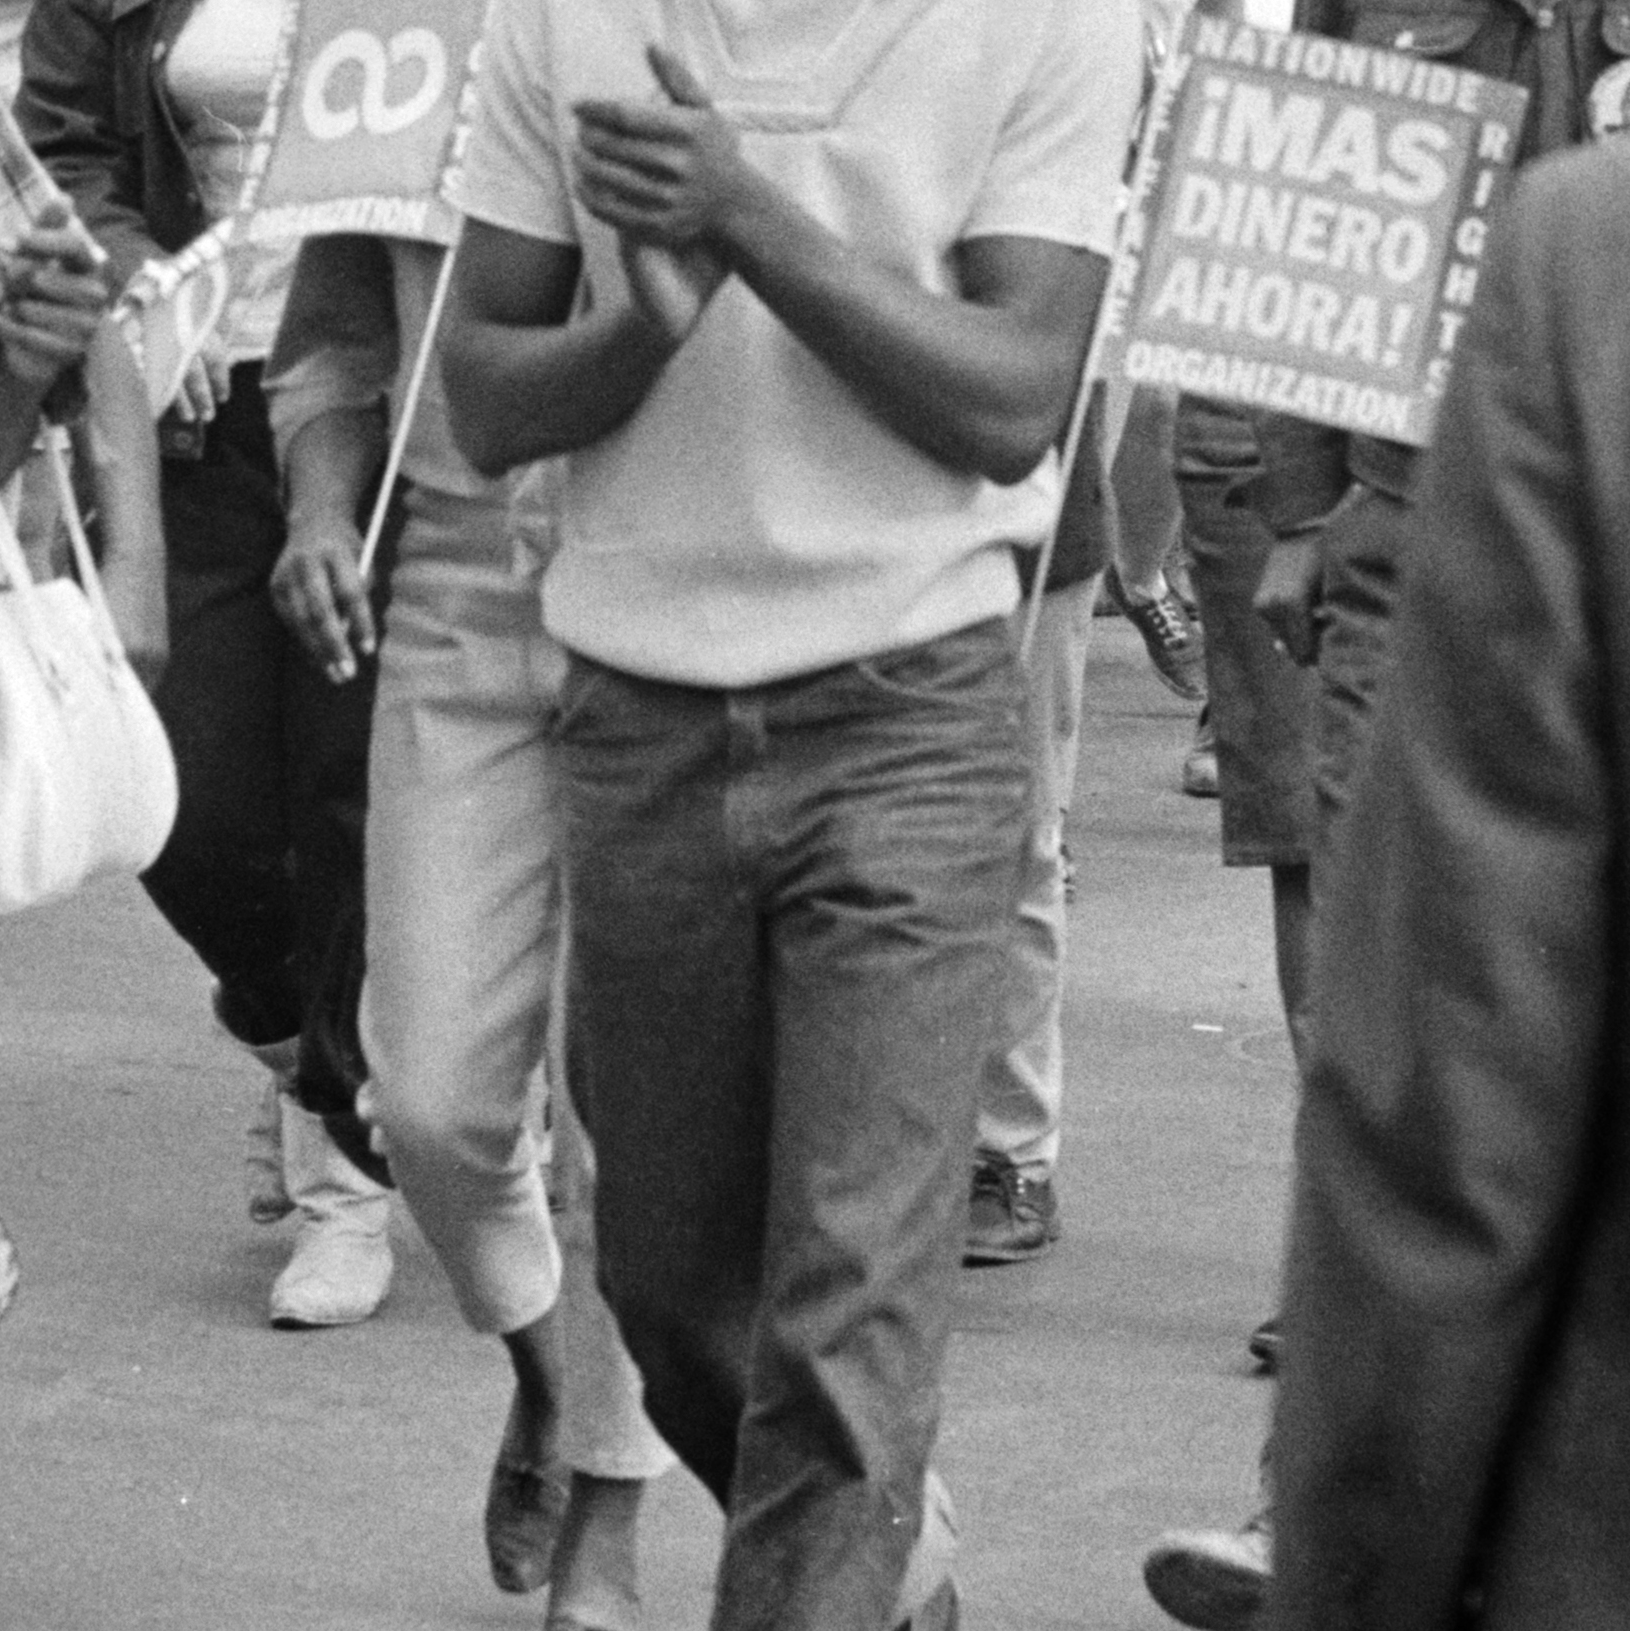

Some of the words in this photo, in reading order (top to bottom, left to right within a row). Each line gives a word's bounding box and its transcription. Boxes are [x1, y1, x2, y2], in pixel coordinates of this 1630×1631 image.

[1197, 14, 1486, 115] NATIONWIDE
[1191, 74, 1452, 206] ¡MAS
[1172, 174, 1430, 284] DINERO
[1423, 120, 1511, 399] RIGHTS
[1150, 256, 1414, 368] AHORA!
[1125, 338, 1412, 432] ORGANIZATION
